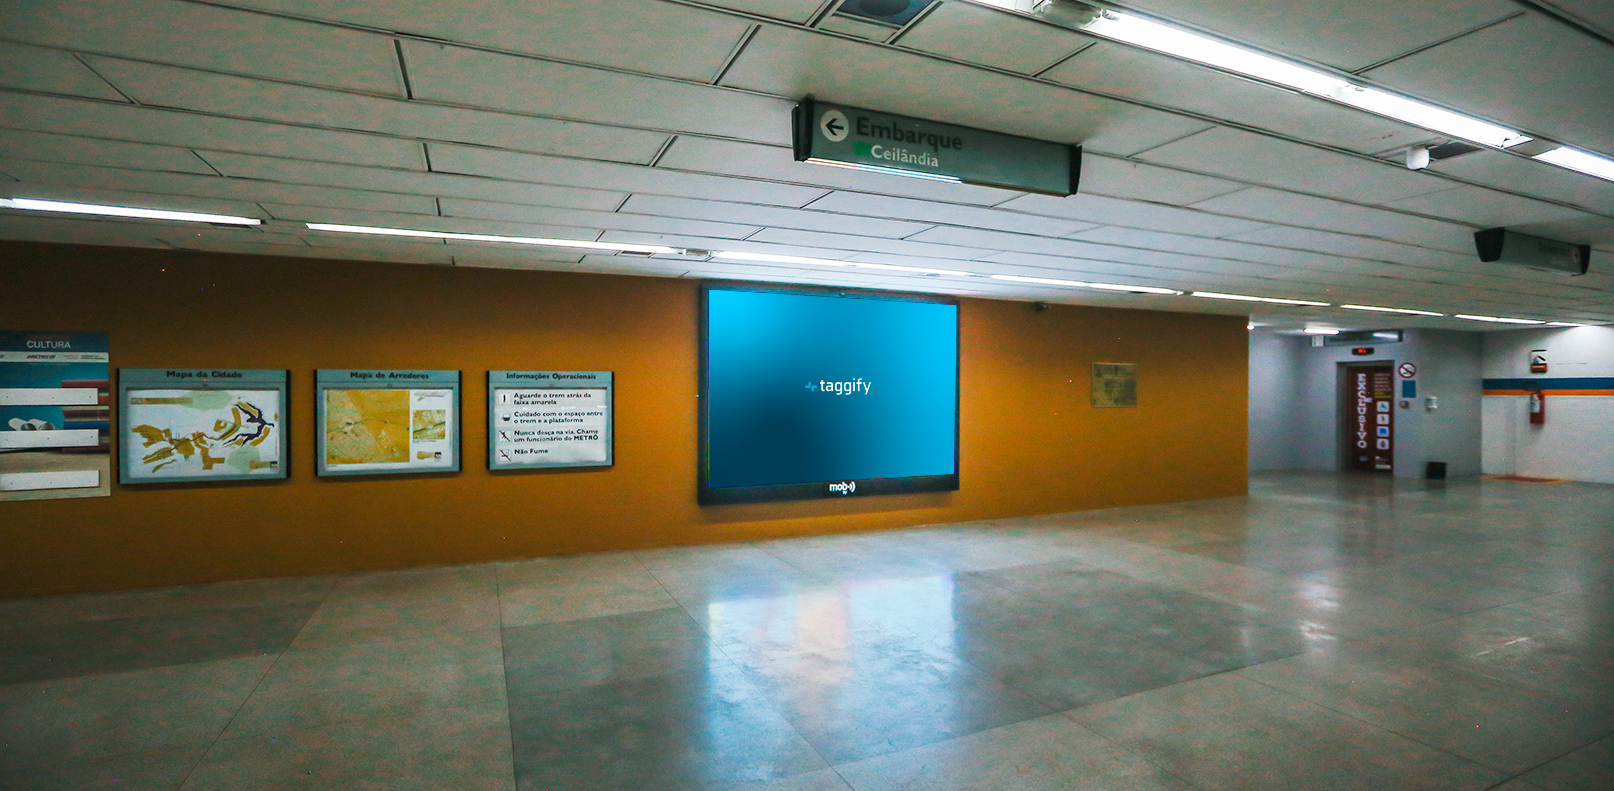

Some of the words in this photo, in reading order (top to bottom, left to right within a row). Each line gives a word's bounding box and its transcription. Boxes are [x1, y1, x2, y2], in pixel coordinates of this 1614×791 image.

[856, 116, 963, 151] Embarque
[871, 145, 939, 167] Ceilândia
[26, 340, 71, 349] CULTURA
[166, 370, 193, 379] Mapa
[211, 371, 243, 379] Cidade
[350, 371, 373, 380] Mapa
[388, 372, 429, 380] Arredores
[820, 378, 871, 395] taggify
[513, 392, 542, 400] Aguarde
[1357, 373, 1367, 449] EXCLUSIVO
[548, 416, 584, 425] plataforma
[536, 429, 555, 437] desça
[526, 434, 563, 442] funcionário
